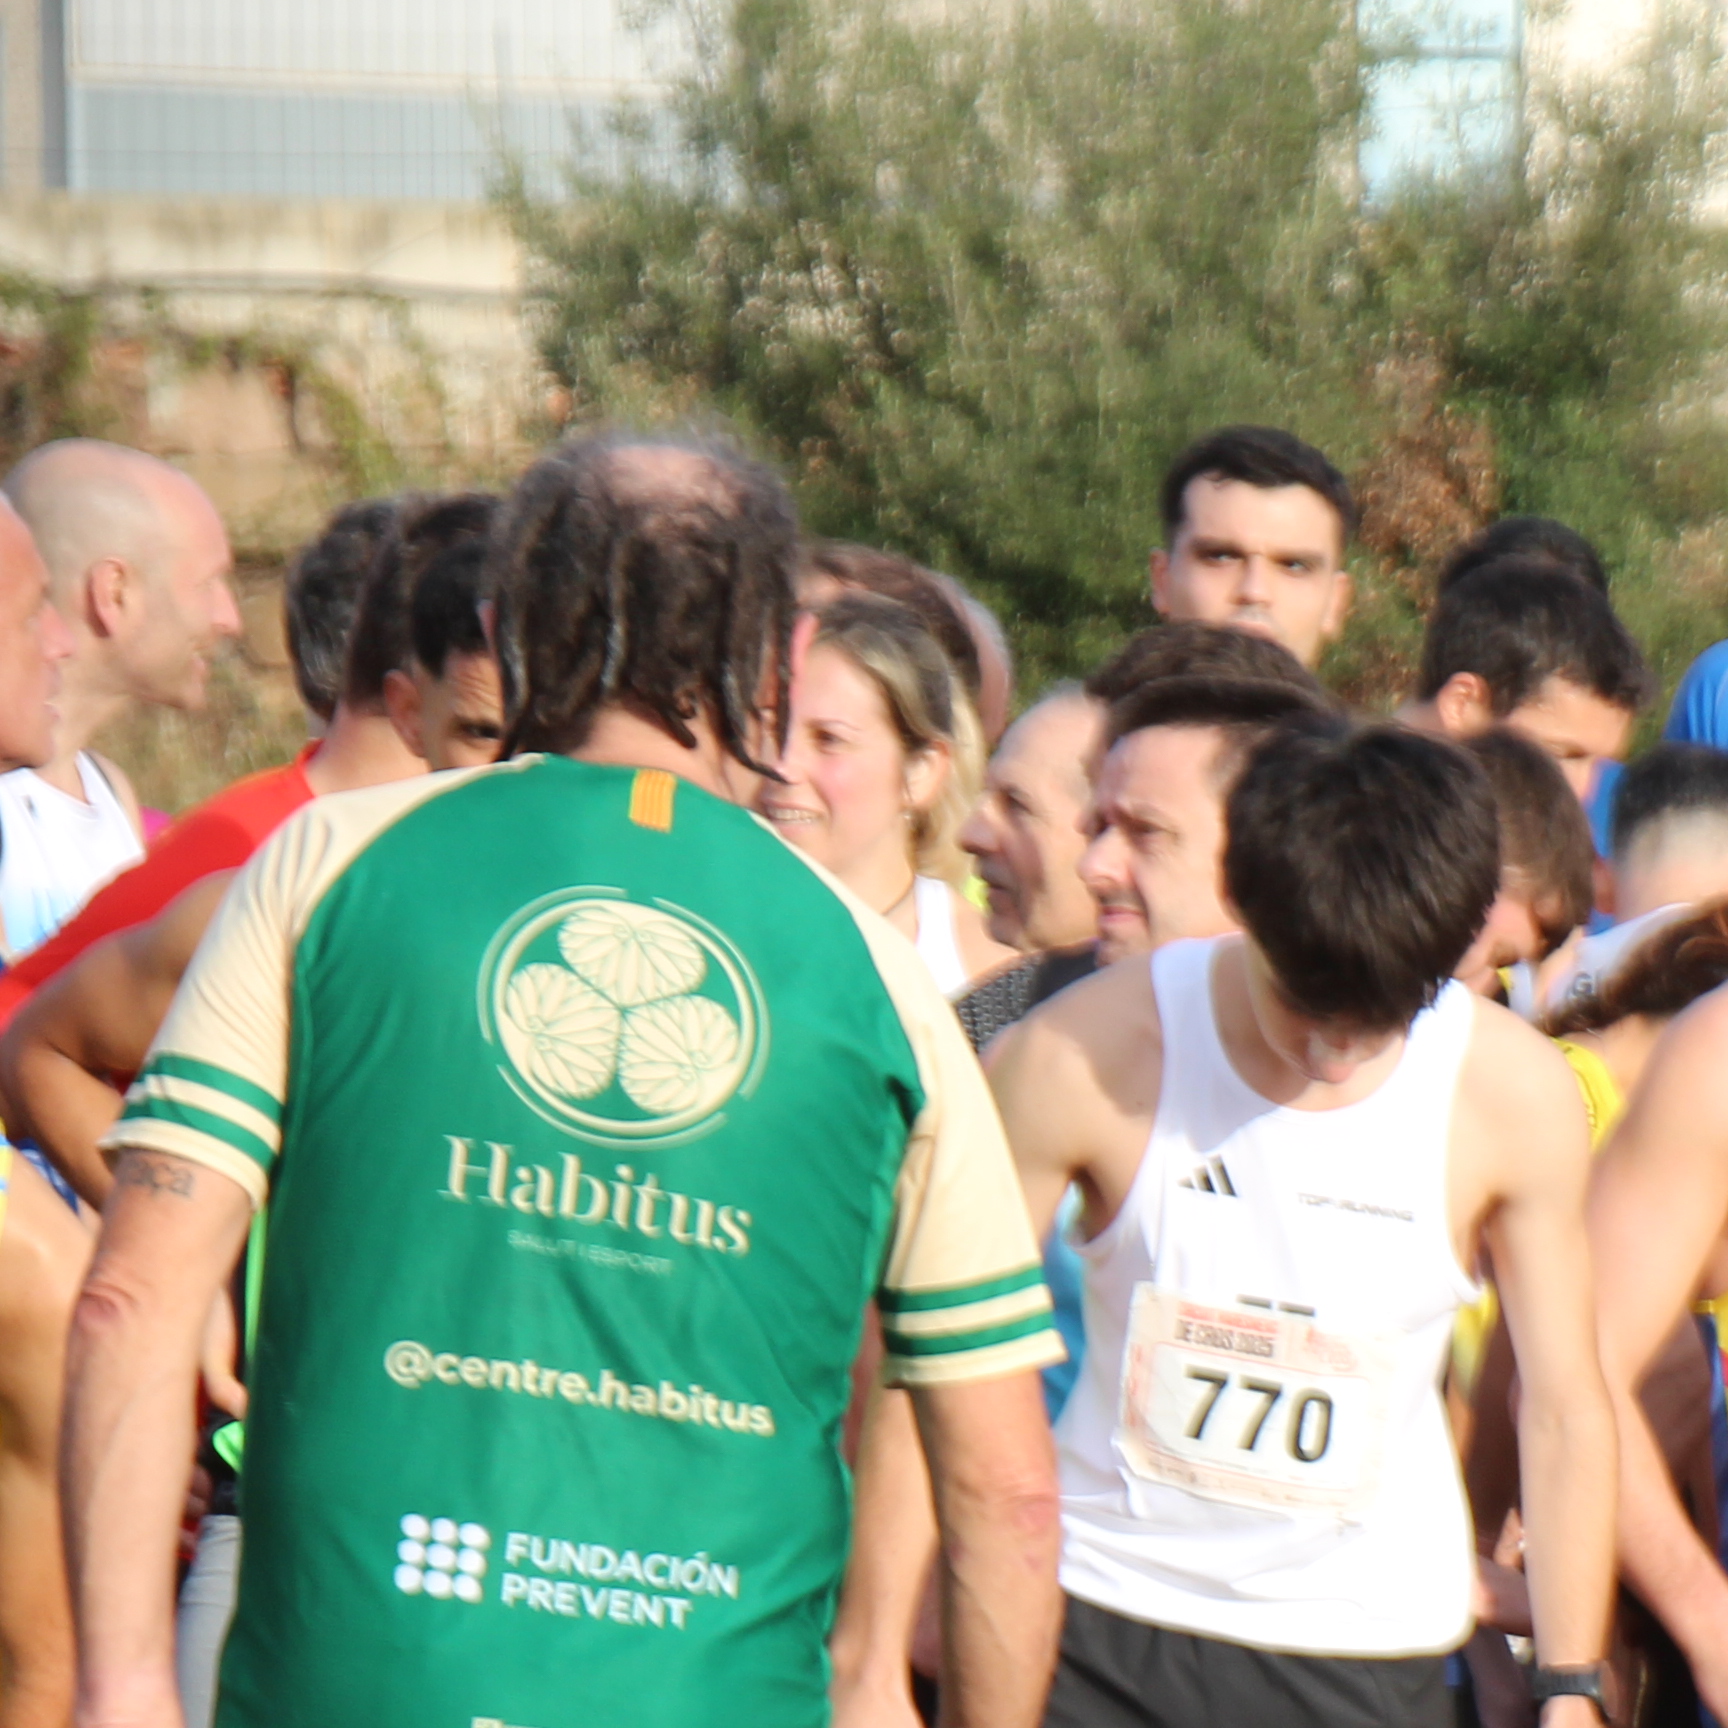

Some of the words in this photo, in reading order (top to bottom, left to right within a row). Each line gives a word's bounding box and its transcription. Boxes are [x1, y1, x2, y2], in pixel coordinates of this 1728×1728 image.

[436, 1134, 753, 1256] Habitus
[383, 1339, 777, 1438] @centre.habitus
[1182, 1362, 1335, 1463] 770
[501, 1571, 694, 1631] PREVENT
[504, 1530, 740, 1600] FUNDACIÓN
